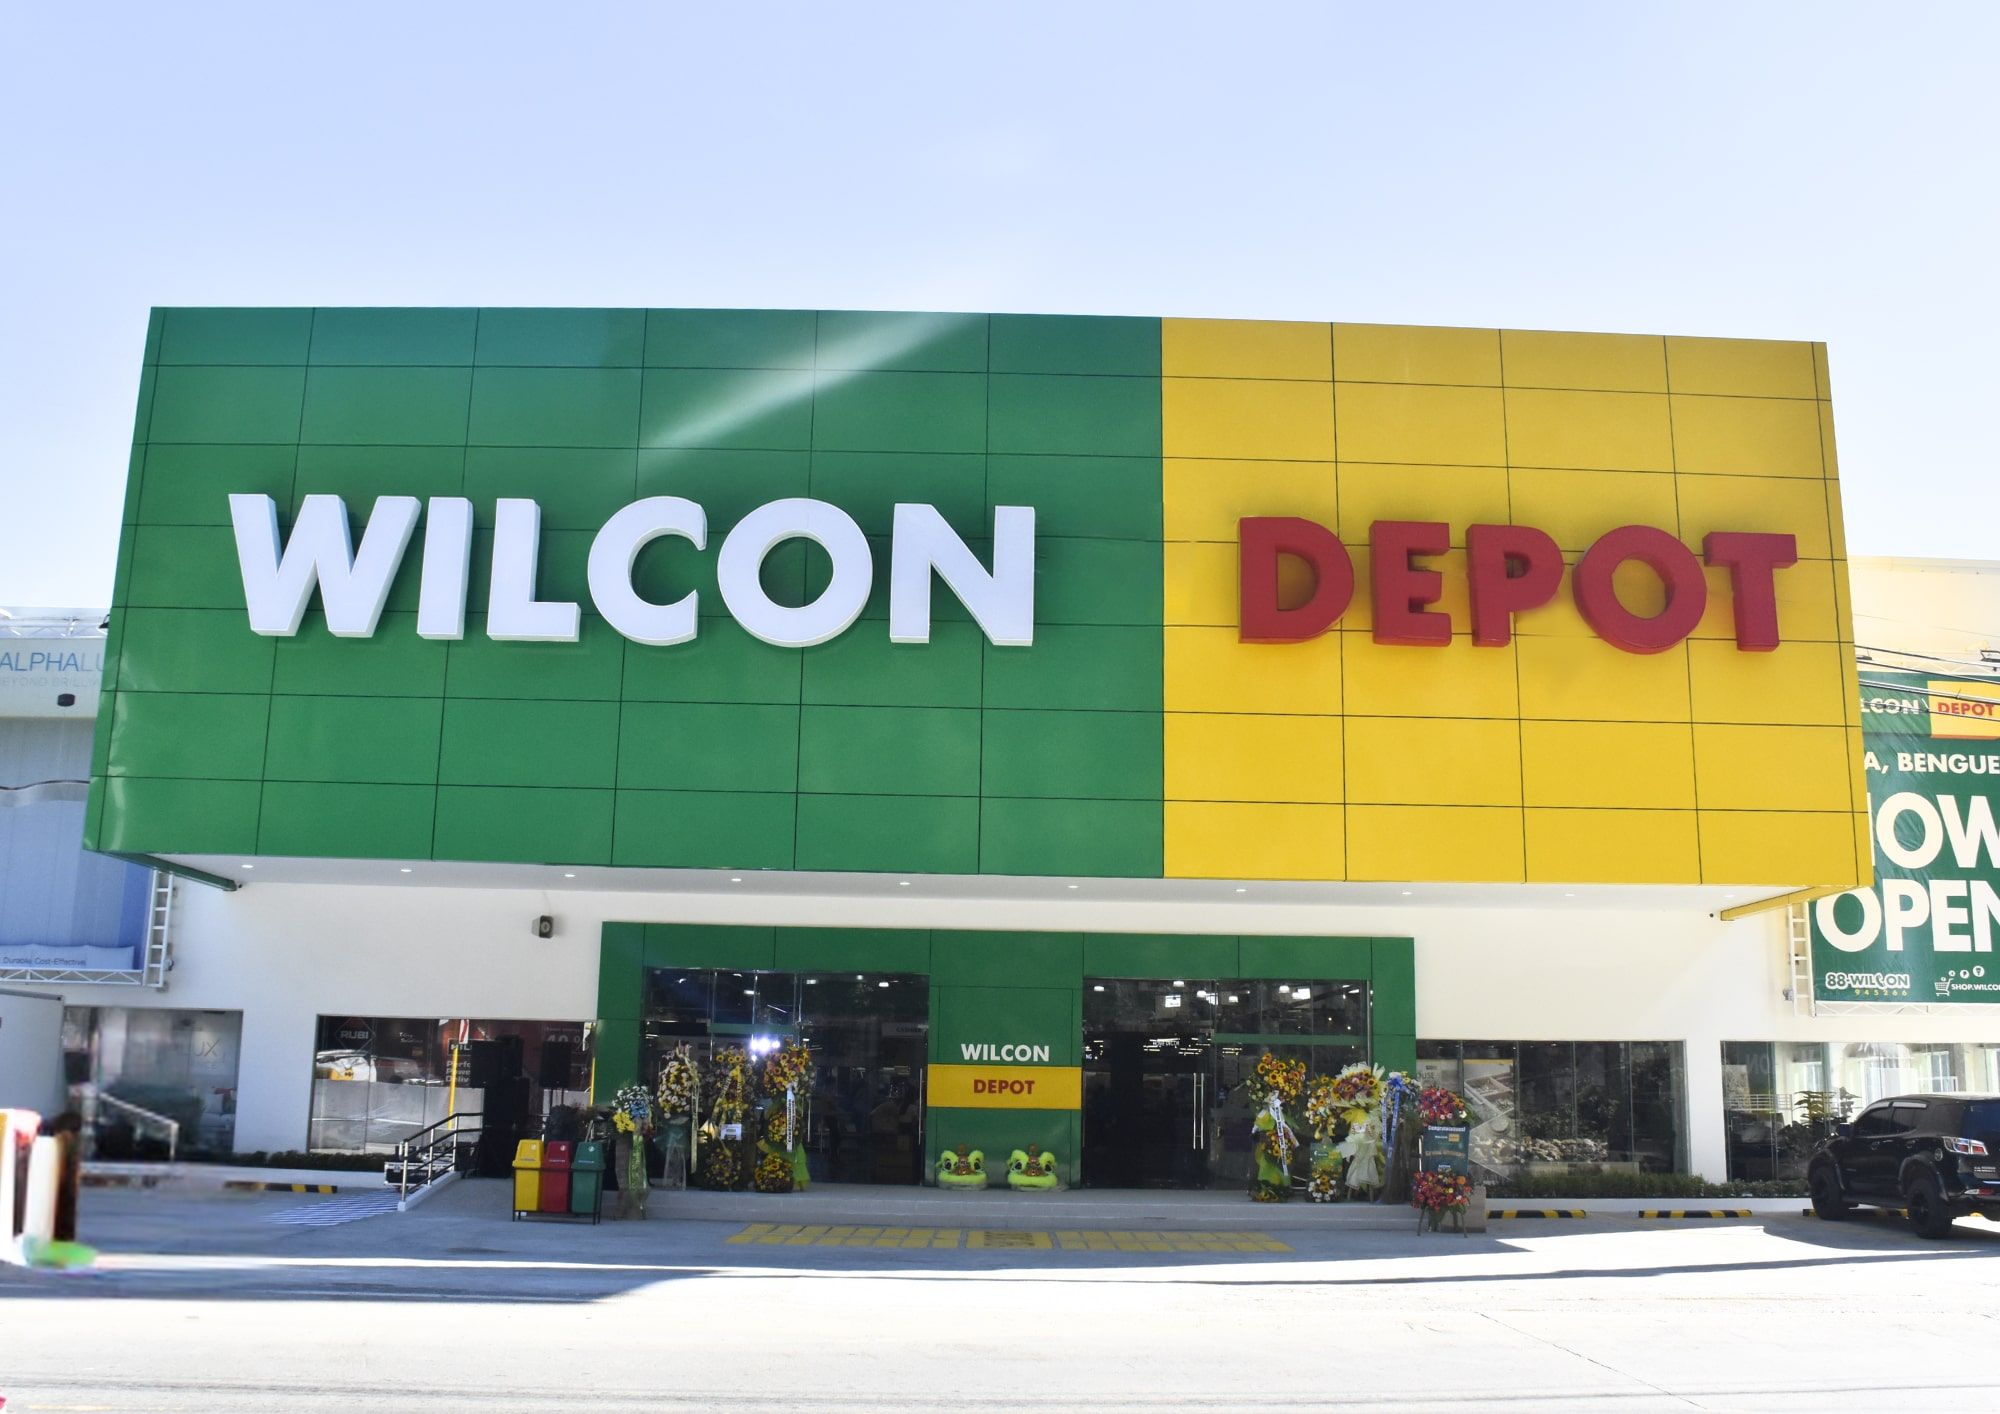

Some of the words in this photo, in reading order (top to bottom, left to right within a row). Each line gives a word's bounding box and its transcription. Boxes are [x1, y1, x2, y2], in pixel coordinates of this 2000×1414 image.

[228, 493, 1036, 647] WILCON
[1238, 516, 1797, 655] DEPOT
[1937, 702, 1994, 716] DEPOT
[340, 1030, 369, 1039] RUBI
[961, 1043, 1049, 1061] WILCON
[973, 1079, 1035, 1094] DEPOT
